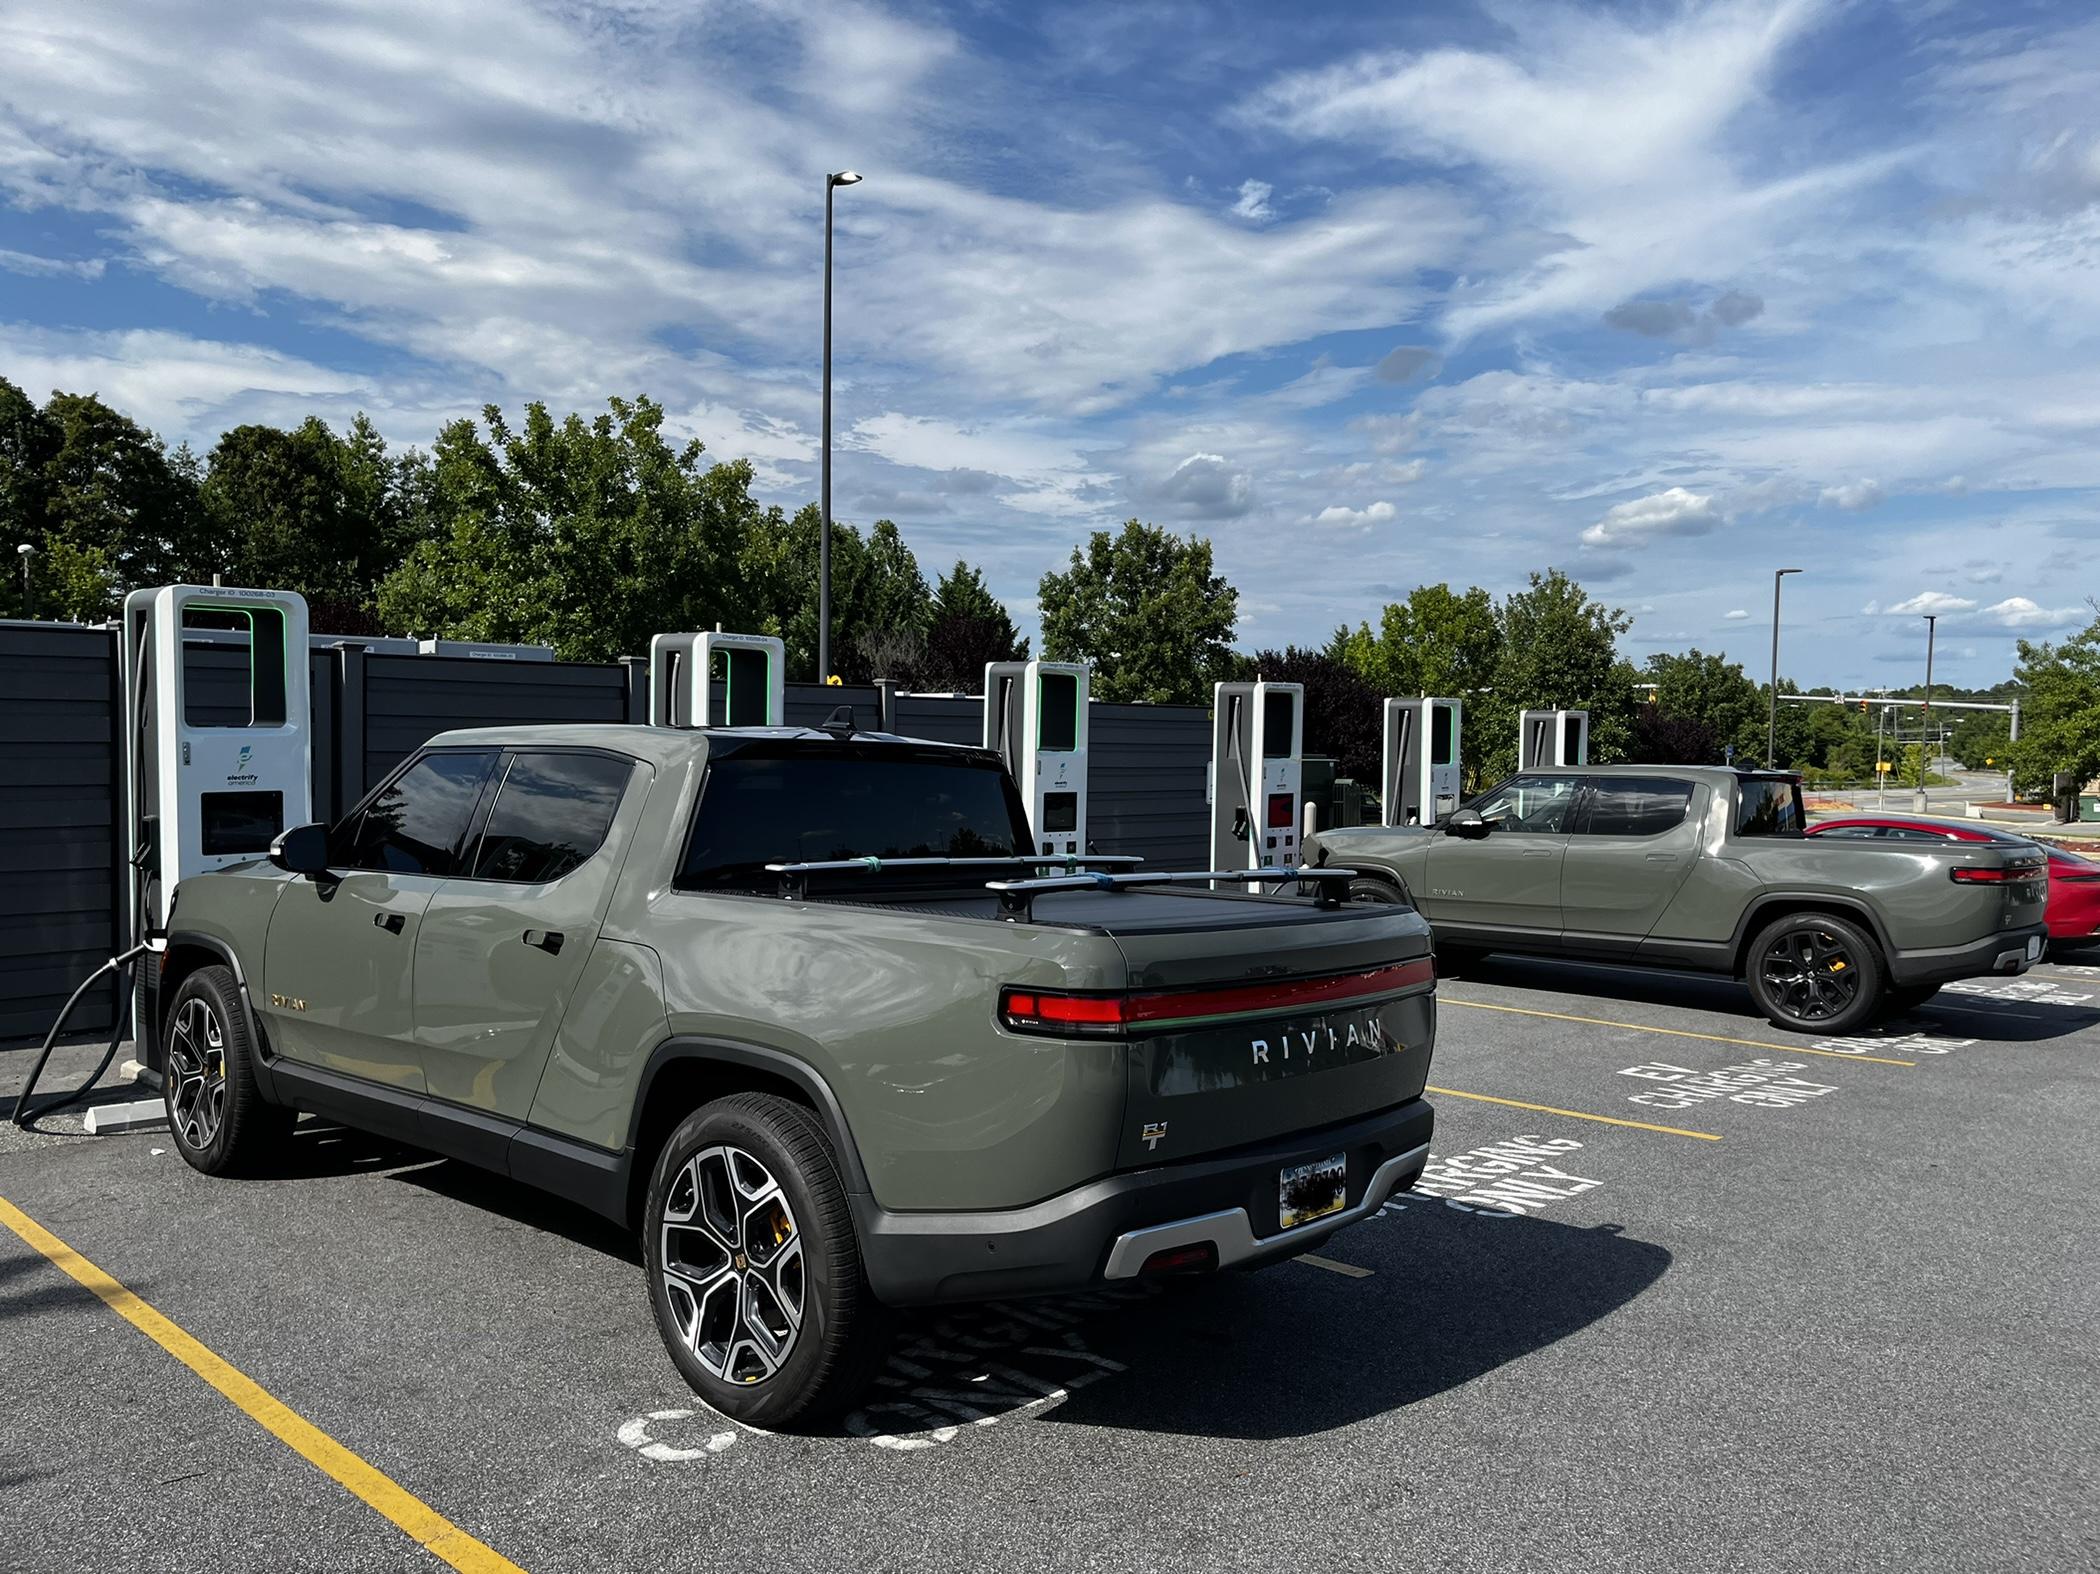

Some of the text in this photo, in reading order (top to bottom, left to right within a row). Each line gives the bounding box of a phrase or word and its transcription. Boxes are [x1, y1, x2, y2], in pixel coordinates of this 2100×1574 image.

[1432, 888, 1464, 897] RIVIAN
[1251, 1018, 1382, 1065] RIVIAN
[1616, 1061, 1700, 1082] EV
[1627, 1058, 1809, 1109] CHARGING
[1728, 1077, 1840, 1108] ONLY
[1445, 1165, 1604, 1218] ONLY
